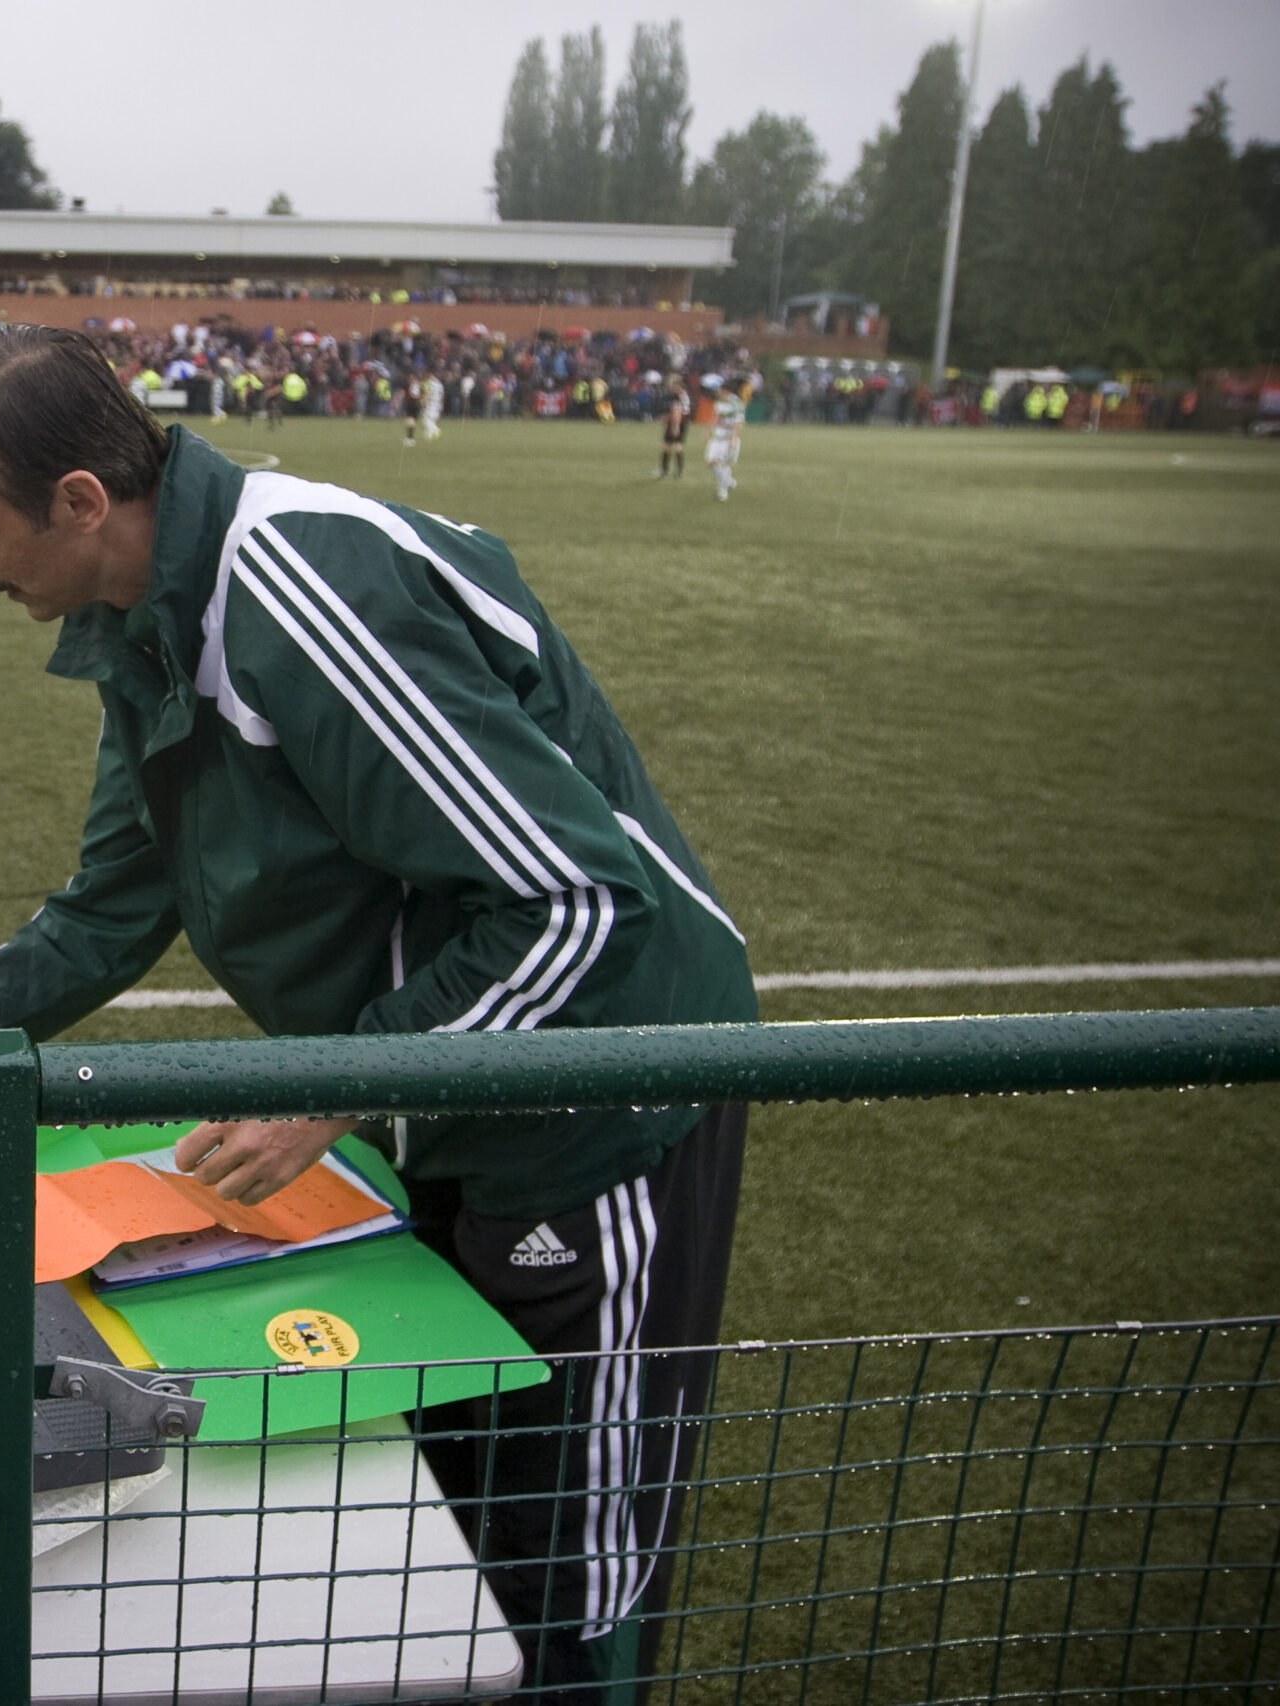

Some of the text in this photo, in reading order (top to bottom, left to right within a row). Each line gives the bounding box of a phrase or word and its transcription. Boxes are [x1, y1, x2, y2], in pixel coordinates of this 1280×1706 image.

[509, 1250, 578, 1267] adidas
[316, 1315, 350, 1357] FAIR PLAY
